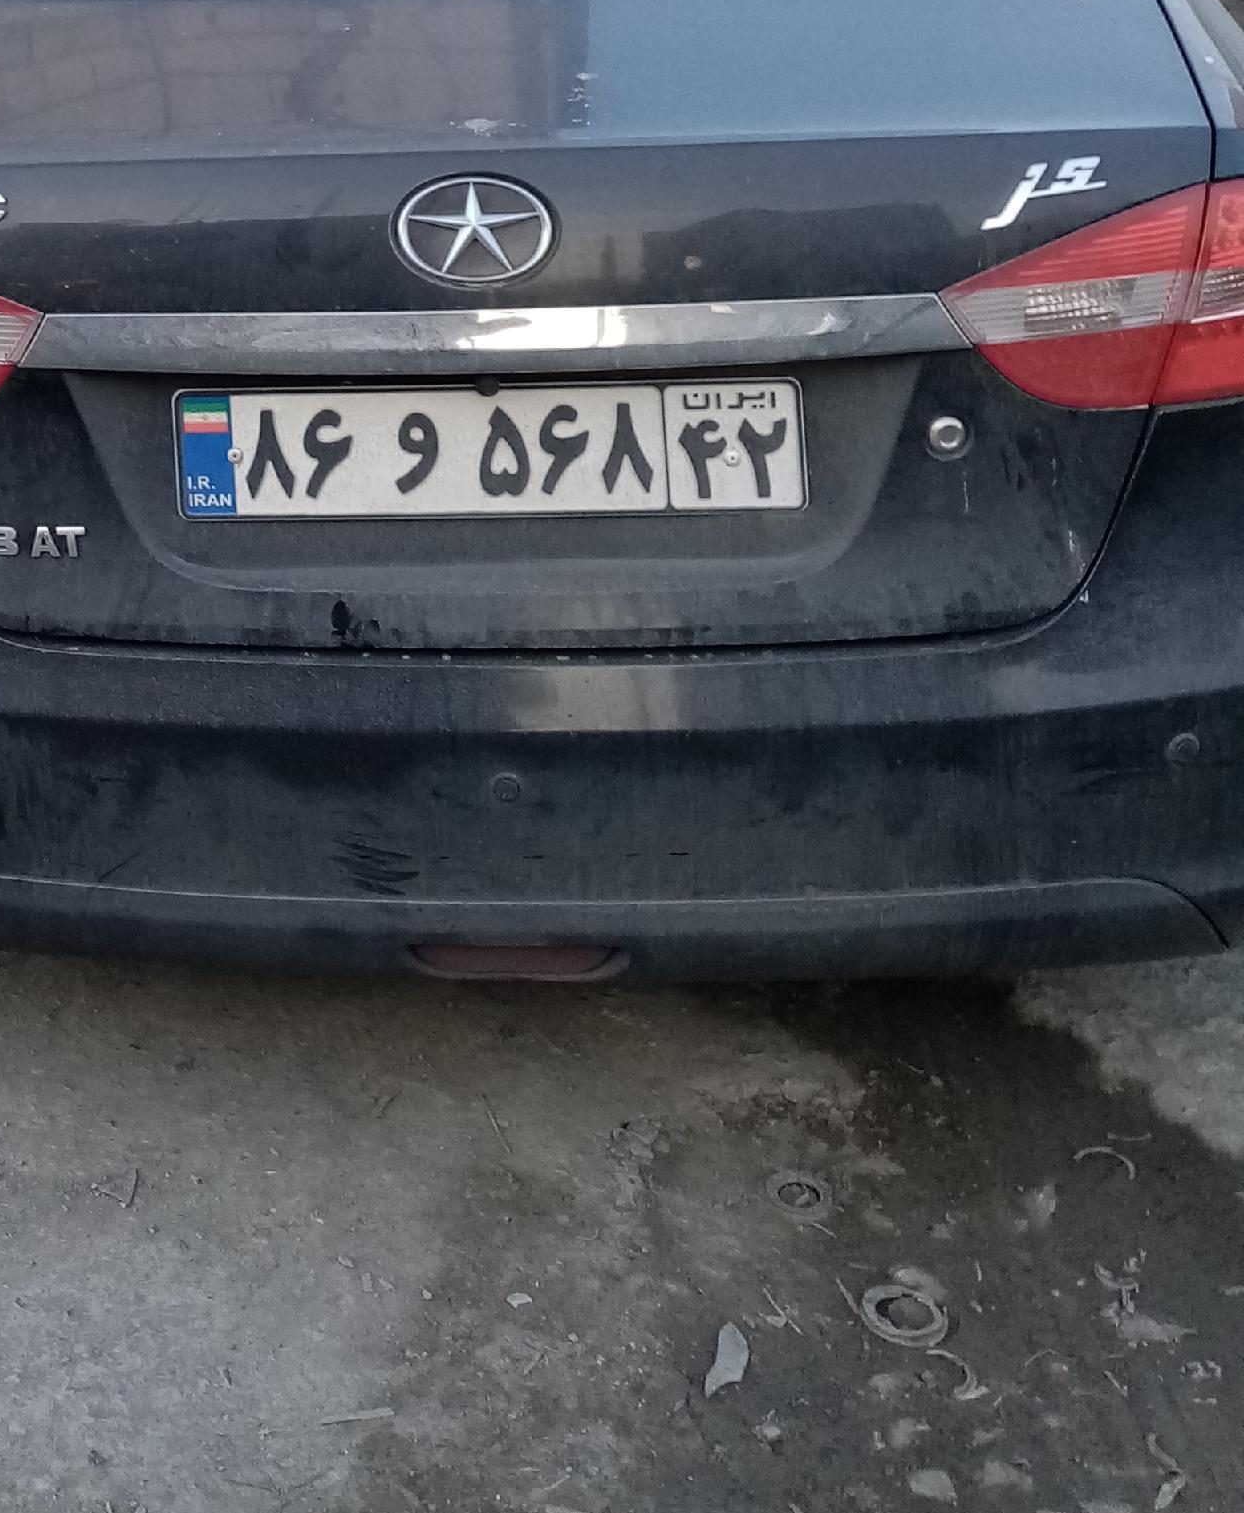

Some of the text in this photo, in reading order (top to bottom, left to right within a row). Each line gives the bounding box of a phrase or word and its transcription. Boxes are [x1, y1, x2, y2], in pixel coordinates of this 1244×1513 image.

[683, 391, 776, 410] ایران
[246, 402, 654, 500] ۸۶ و ۵۶۸
[677, 417, 787, 499] ۴۲
[186, 475, 216, 490] I.R.
[188, 492, 233, 508] IRAN
[31, 526, 86, 558] AT
